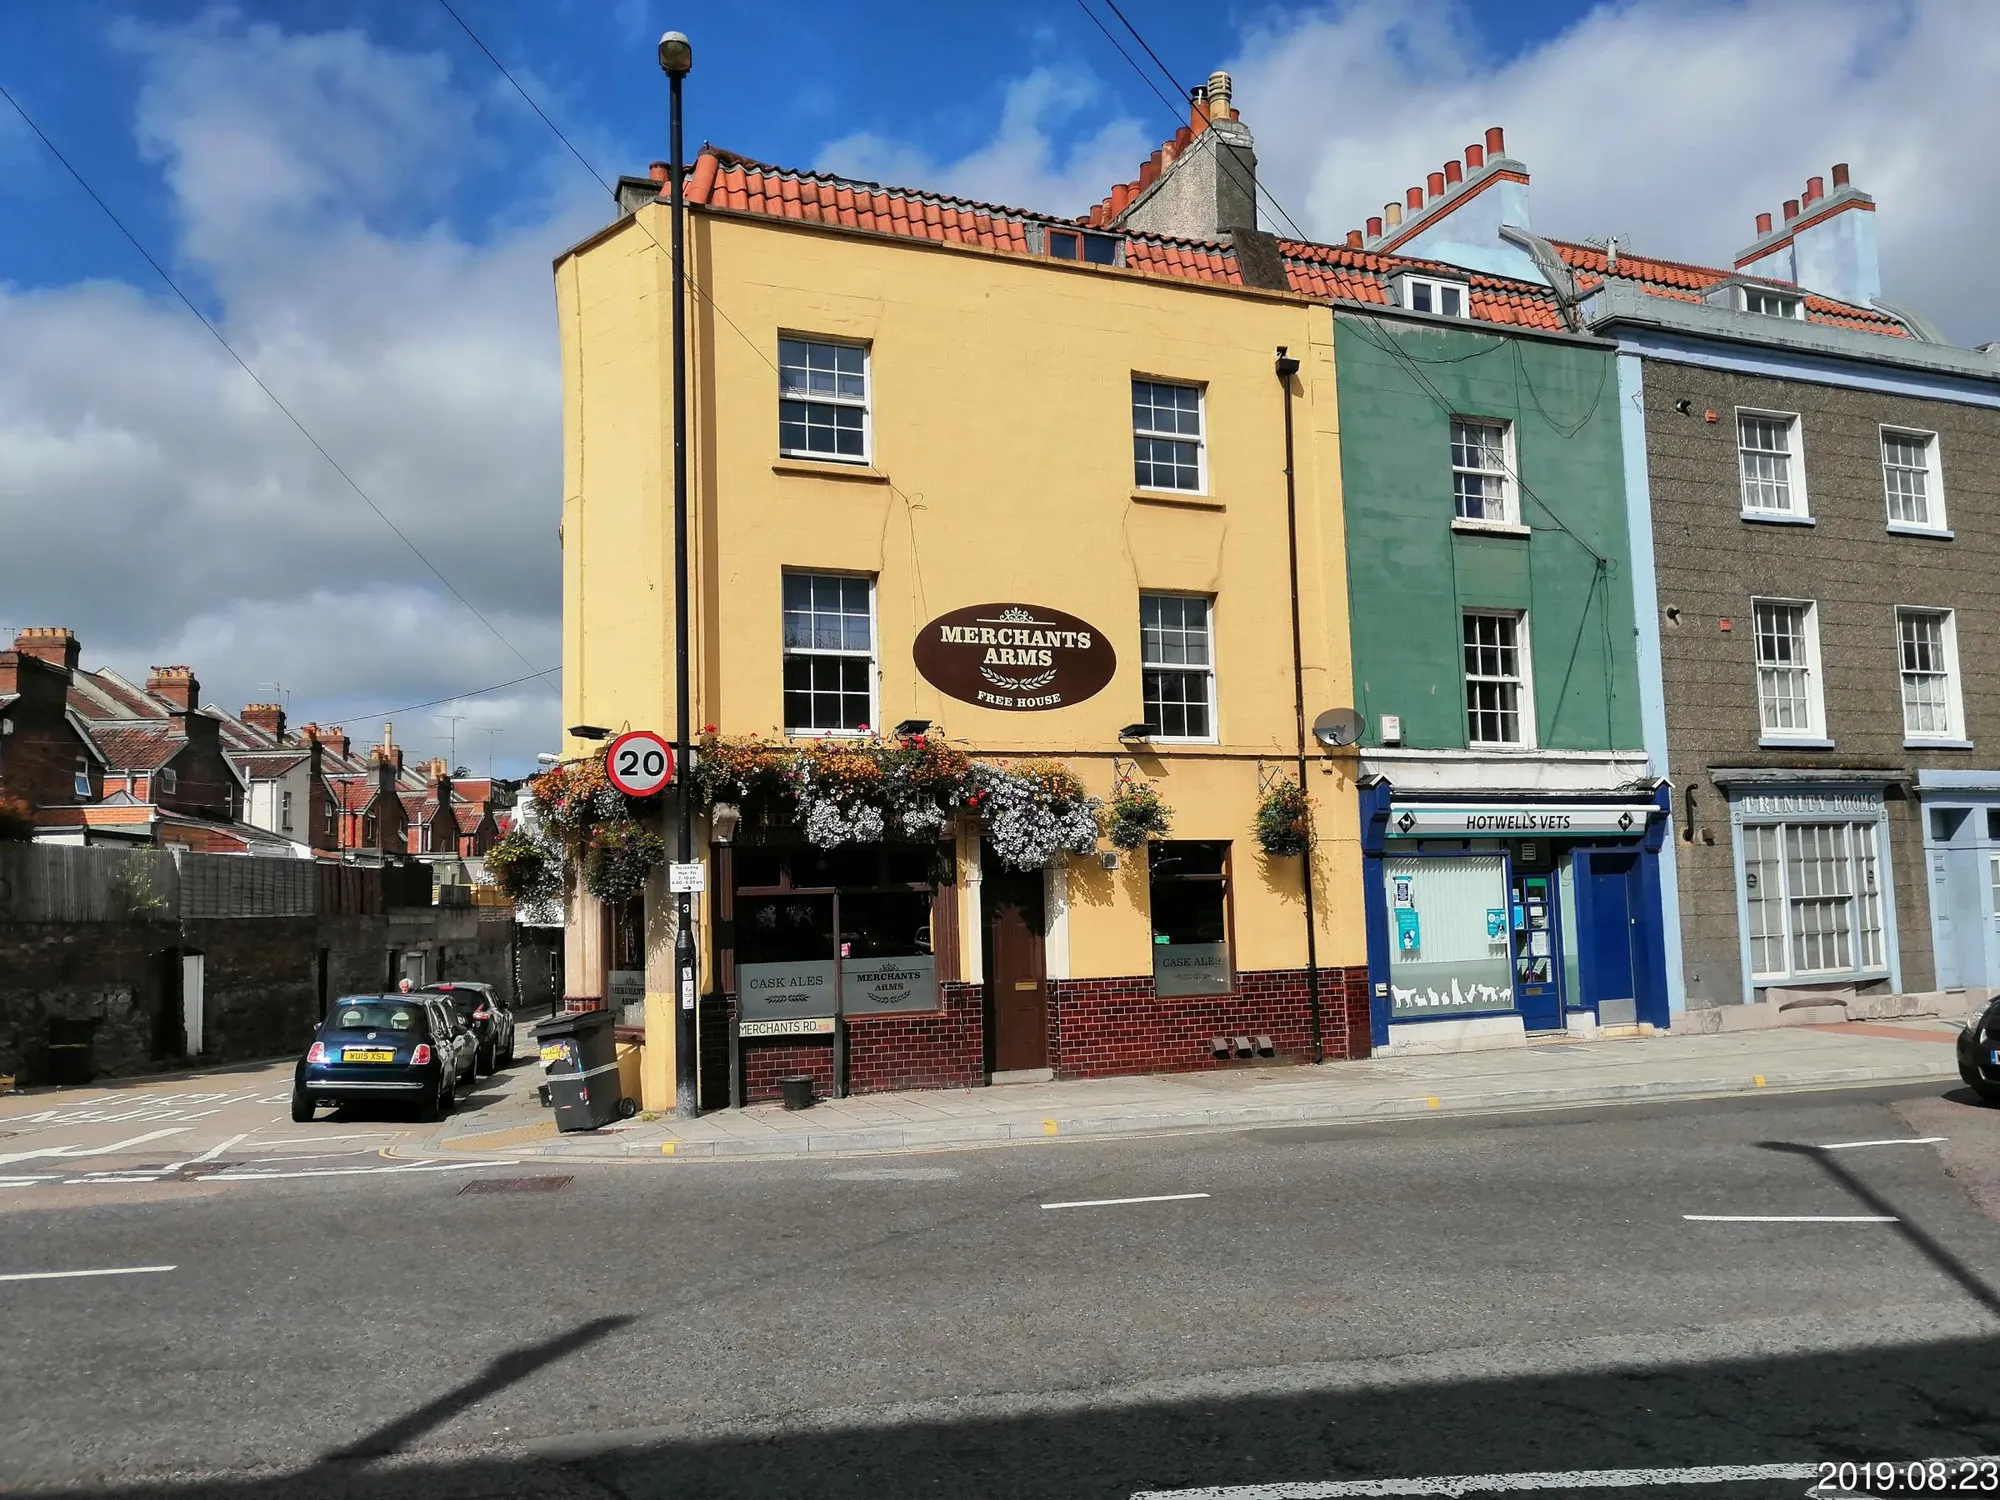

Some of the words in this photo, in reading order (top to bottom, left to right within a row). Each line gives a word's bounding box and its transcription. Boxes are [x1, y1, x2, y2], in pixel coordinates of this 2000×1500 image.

[940, 625, 1092, 649] MERCHANTS
[983, 648, 1053, 667] ARMS
[977, 690, 1013, 707] FREE
[1016, 692, 1061, 708] HOUSE
[619, 750, 665, 776] 20
[1742, 795, 1827, 816] TRINITY
[1833, 794, 1878, 813] ROOMS
[1466, 815, 1537, 830] HOTWELLS
[1540, 815, 1571, 829] VETS
[683, 904, 689, 913] 3
[1162, 957, 1191, 968] CASK
[1194, 957, 1222, 967] ALES
[750, 977, 787, 990] CASK
[789, 975, 824, 988] ALES
[856, 971, 921, 983] MERCHANTS
[612, 987, 645, 996] MERCHANT
[874, 982, 904, 992] ARMS
[739, 1021, 800, 1036] MERCHANTS
